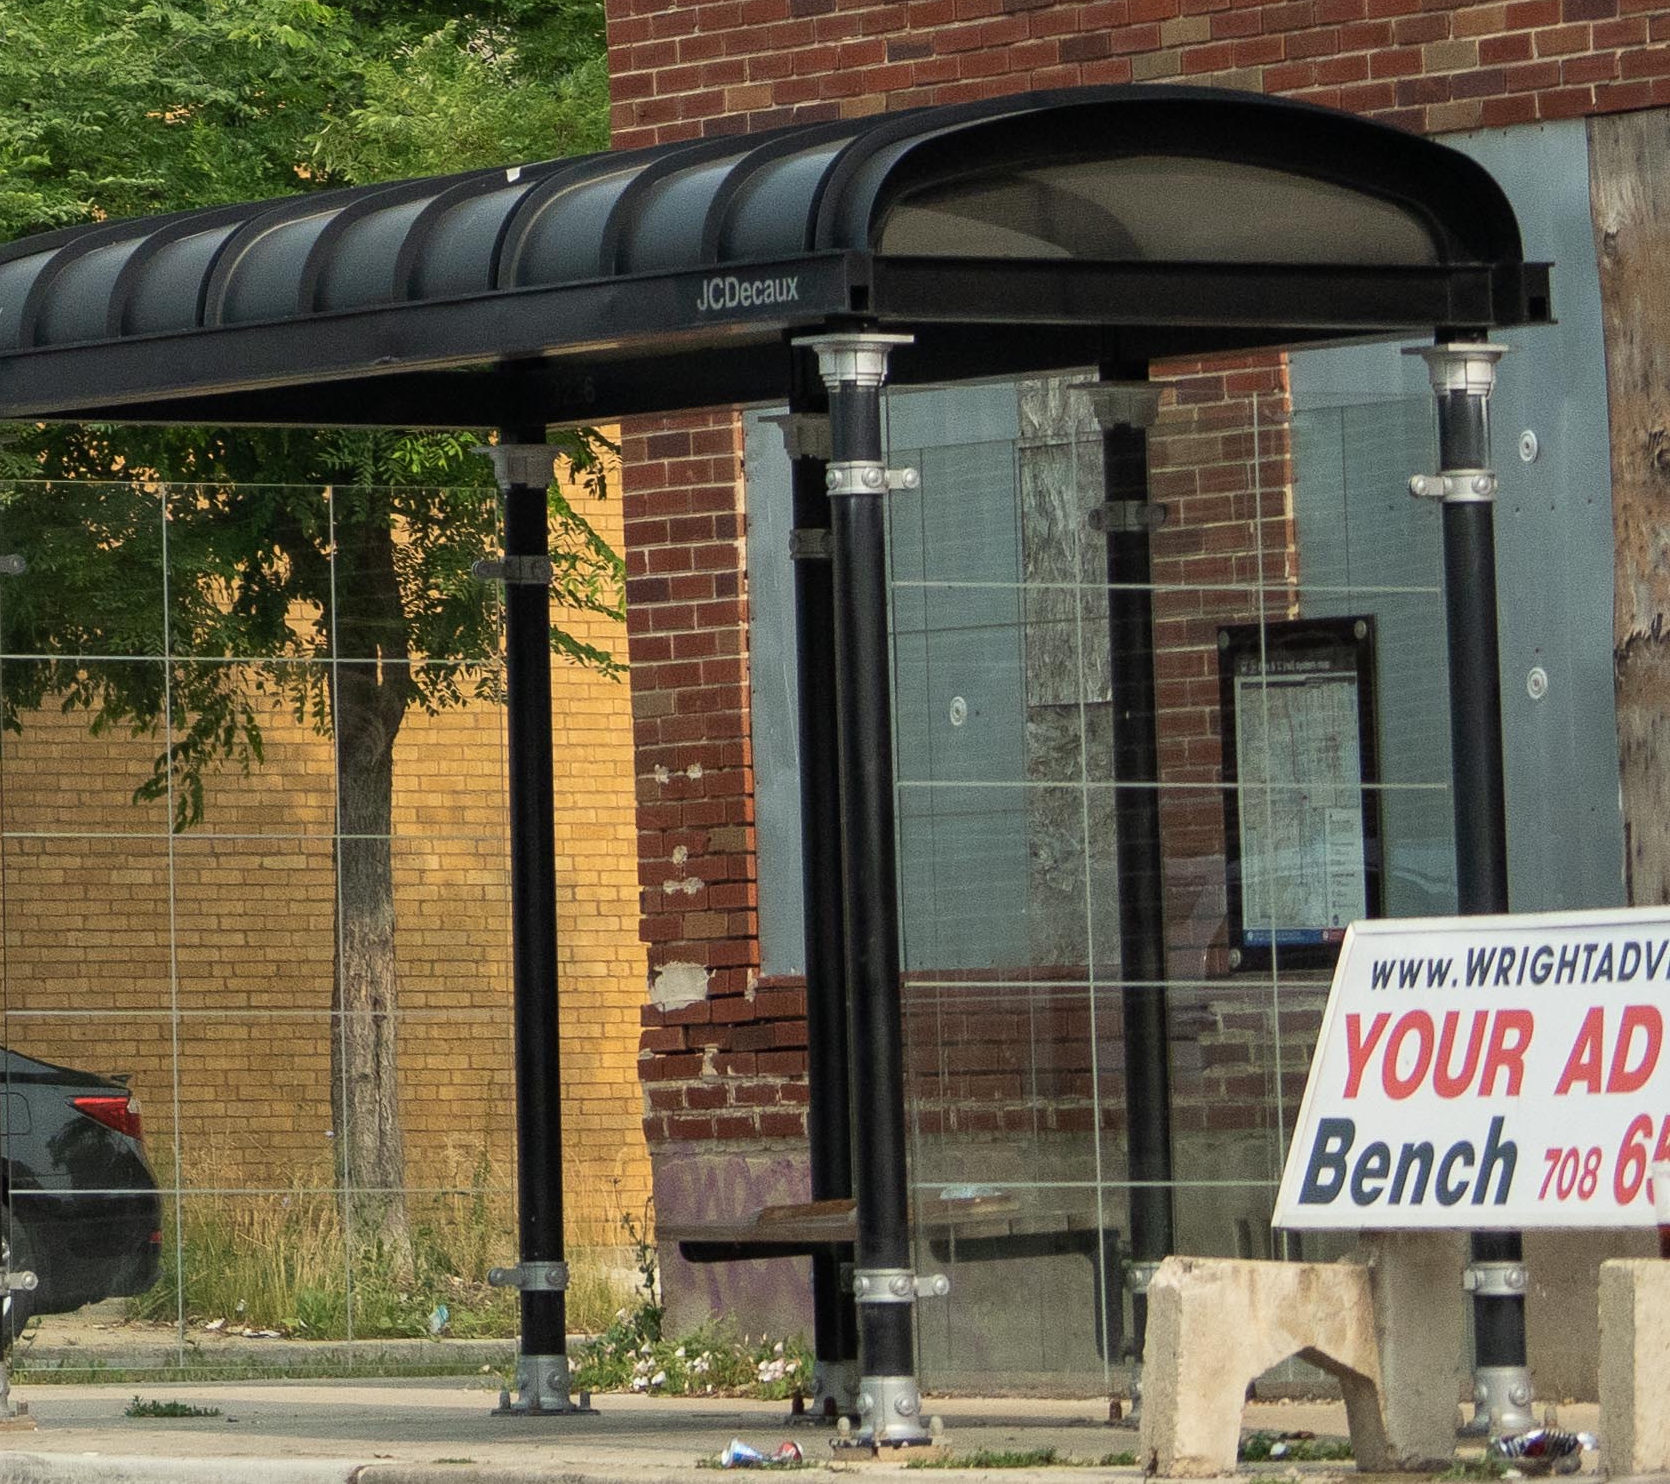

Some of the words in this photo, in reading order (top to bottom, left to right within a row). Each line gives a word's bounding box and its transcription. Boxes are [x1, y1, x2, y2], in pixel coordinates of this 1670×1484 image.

[697, 276, 799, 311] JCDecaux
[1371, 939, 1670, 991] www.WRIGHTADV
[1342, 1008, 1535, 1101] YOUR
[1553, 1003, 1664, 1096] AD
[1298, 1115, 1519, 1207] Bench
[1538, 1146, 1602, 1202] 708
